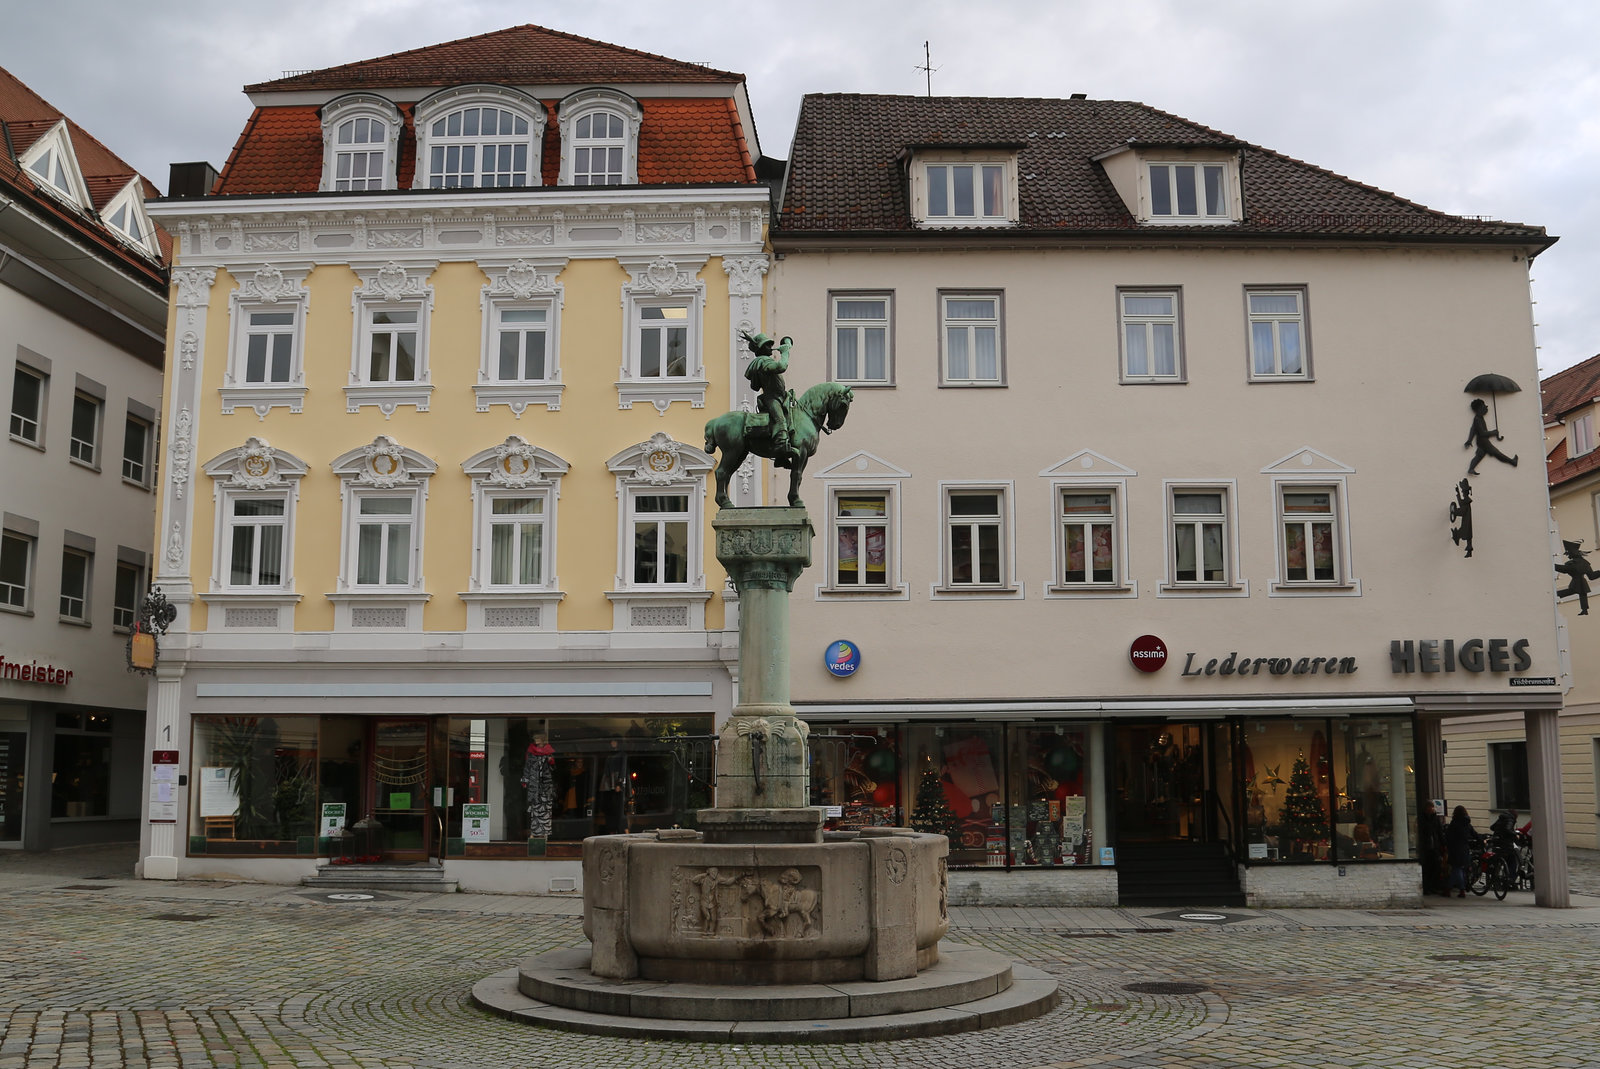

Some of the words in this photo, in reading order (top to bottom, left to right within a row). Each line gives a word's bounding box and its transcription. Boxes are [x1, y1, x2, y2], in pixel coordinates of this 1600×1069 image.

[1133, 650, 1165, 658] ASSIMA
[1390, 638, 1532, 673] HEIGES
[830, 662, 855, 671] vedes
[1181, 652, 1358, 676] Lederwaren
[162, 724, 171, 742] 1
